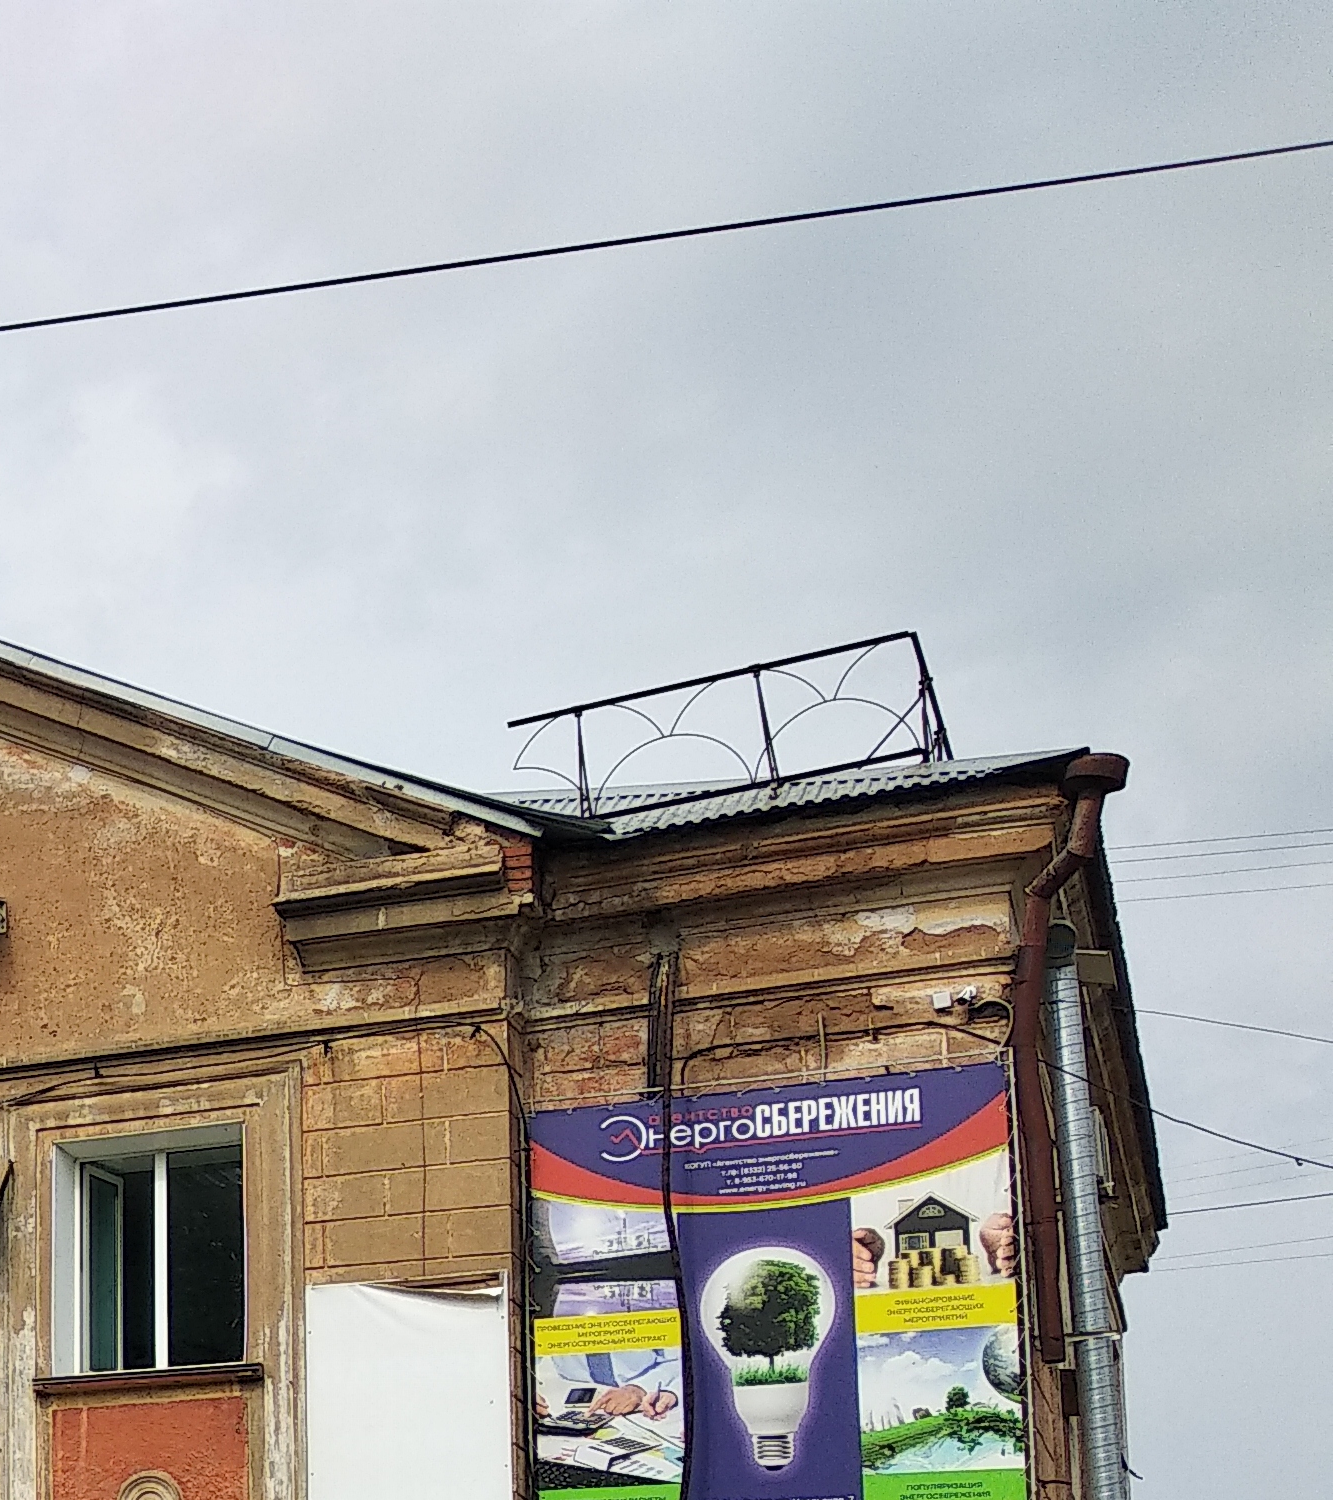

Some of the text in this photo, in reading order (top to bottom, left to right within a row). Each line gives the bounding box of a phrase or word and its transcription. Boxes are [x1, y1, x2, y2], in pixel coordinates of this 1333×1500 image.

[648, 1106, 754, 1125] аентство
[627, 1335, 668, 1343] КОНТРАКТ
[906, 1481, 983, 1491] ПОПУЛЯРИЗАЦИЯ
